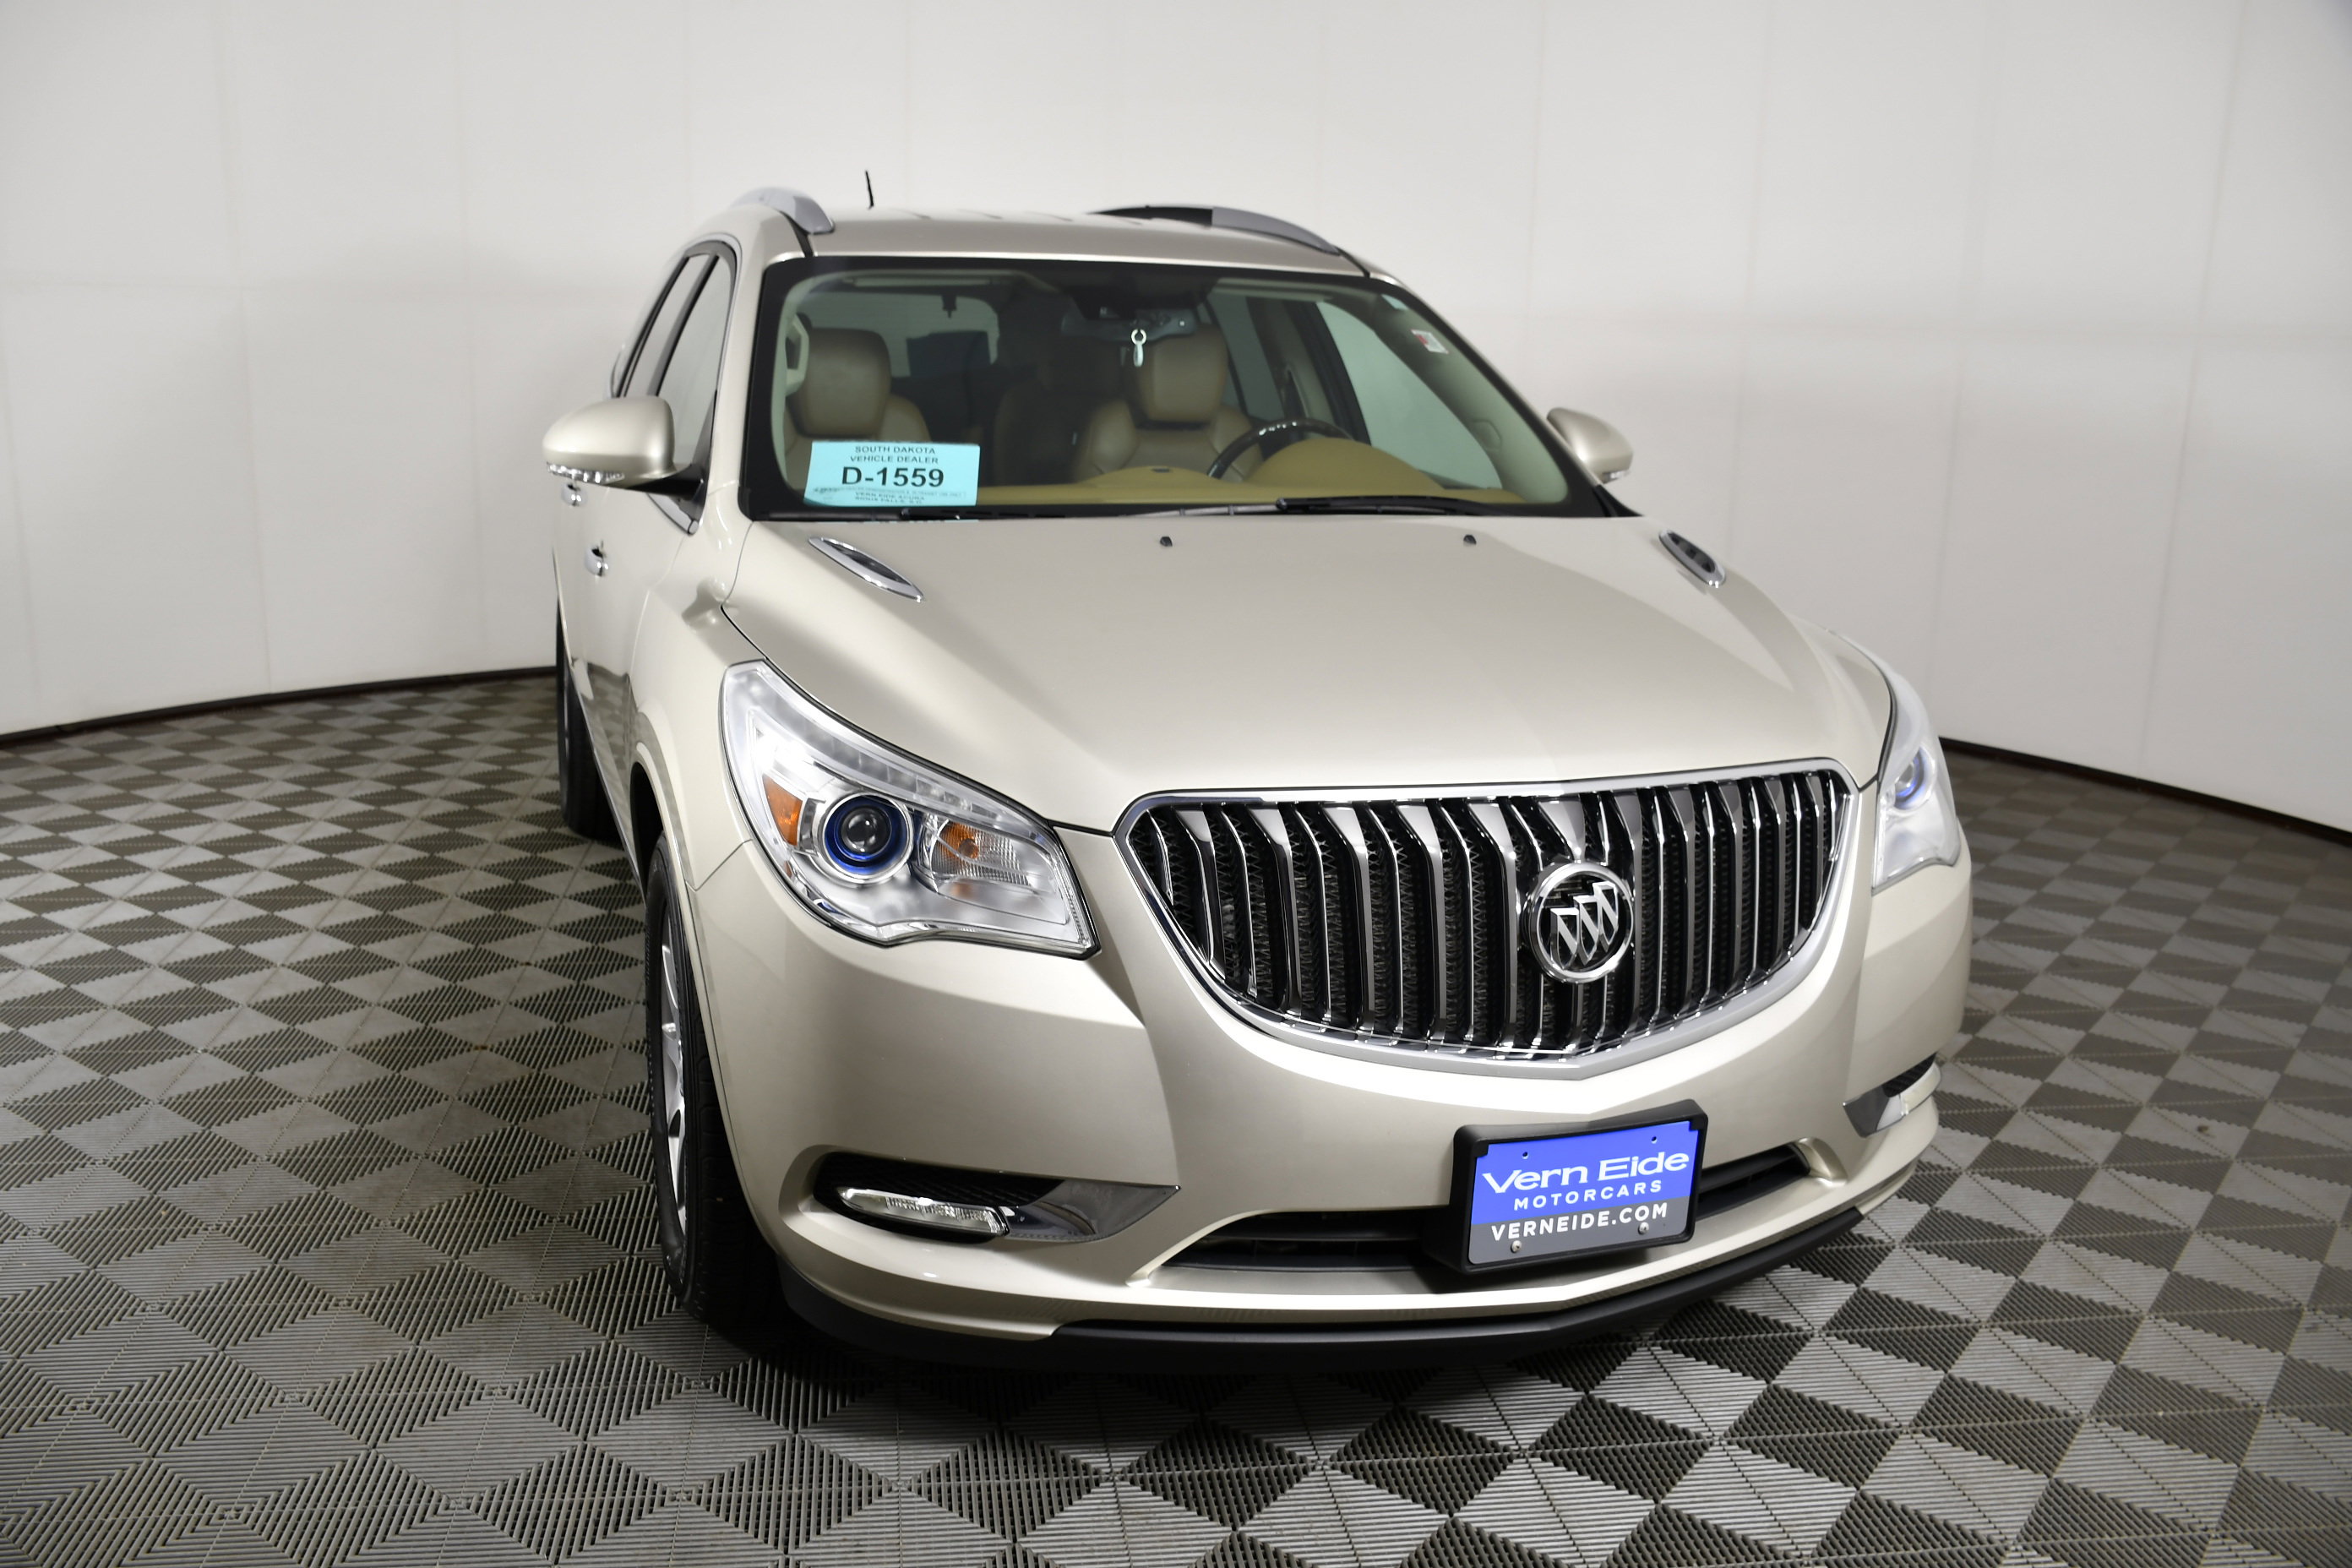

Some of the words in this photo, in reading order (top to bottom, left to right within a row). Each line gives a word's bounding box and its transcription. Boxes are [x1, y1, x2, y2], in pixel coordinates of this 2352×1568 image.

[893, 446, 935, 455] DAKOTA
[896, 456, 939, 465] DEALER
[841, 466, 945, 487] D-1559
[1482, 1165, 1588, 1194] Vern
[1598, 1151, 1690, 1181] Eide
[1513, 1179, 1662, 1211] MOTORCARS
[1490, 1202, 1668, 1241] VERNEIDE.COM
